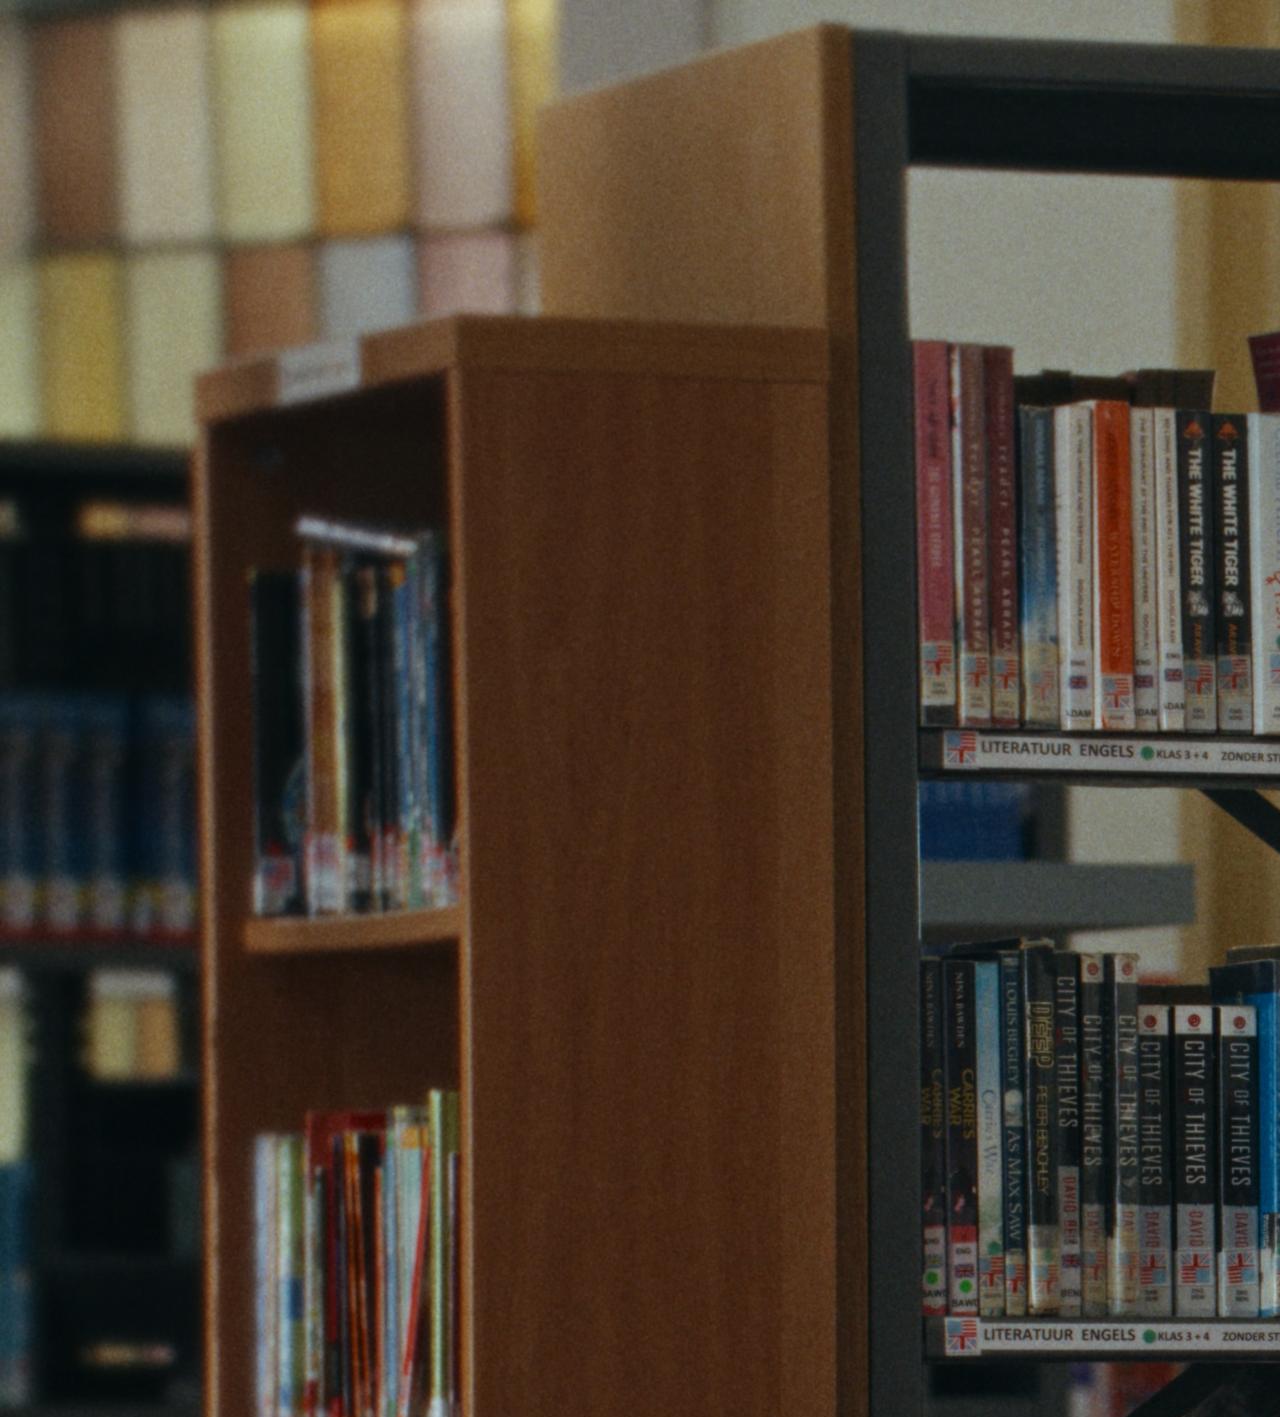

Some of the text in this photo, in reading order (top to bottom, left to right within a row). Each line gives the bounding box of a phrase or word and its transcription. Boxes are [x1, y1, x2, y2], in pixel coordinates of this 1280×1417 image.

[1189, 448, 1203, 585] THE WHITE TIGER
[1221, 449, 1238, 585] THE WHITE TIGER
[982, 741, 1071, 756] LITERATUUR
[1080, 744, 1134, 758] ENGELS
[1157, 750, 1182, 760] KLAS
[1185, 750, 1191, 760] 3
[1202, 751, 1209, 760] 4
[1221, 751, 1264, 762] ZONDER
[1056, 976, 1076, 1015] CITY
[1062, 1027, 1076, 1046] OF
[1059, 1053, 1077, 1127] THIEVES
[1084, 1015, 1102, 1166] CITY OF THIEVES
[1141, 1042, 1160, 1248] CITY OF THIEVES DAVID
[1184, 1040, 1206, 1246] CITY OF THIEVES DAVID
[1230, 1043, 1251, 1248] CITY OF THIEVES DAVID
[984, 1329, 1072, 1341] LITERATUUR
[1082, 1329, 1135, 1341] ENGELS
[1158, 1332, 1184, 1341] KLAS
[1186, 1332, 1193, 1341] 3
[1202, 1332, 1209, 1341] 4
[1222, 1331, 1266, 1341] ZONDER
